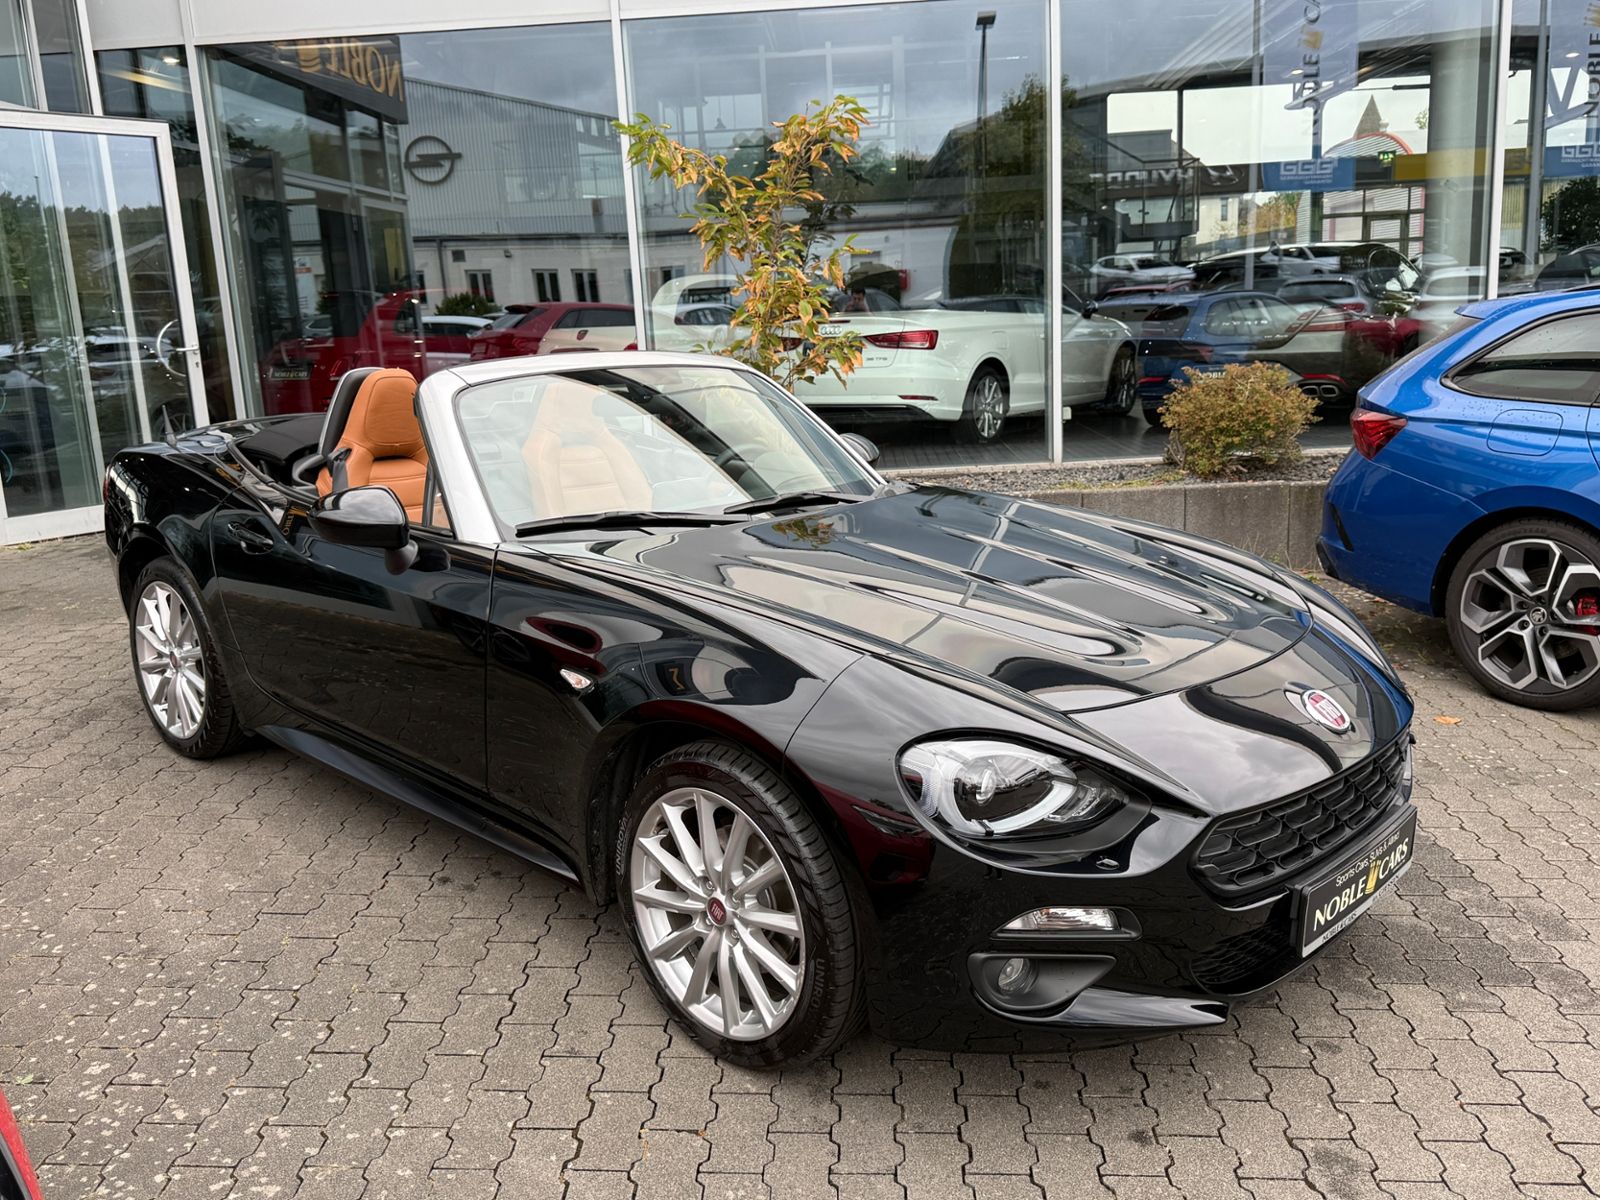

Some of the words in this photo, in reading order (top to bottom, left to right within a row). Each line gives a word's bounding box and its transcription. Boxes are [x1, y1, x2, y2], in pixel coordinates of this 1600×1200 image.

[711, 903, 724, 921] FIAT
[1313, 875, 1366, 932] NOBLE
[1379, 837, 1409, 880] CARS
